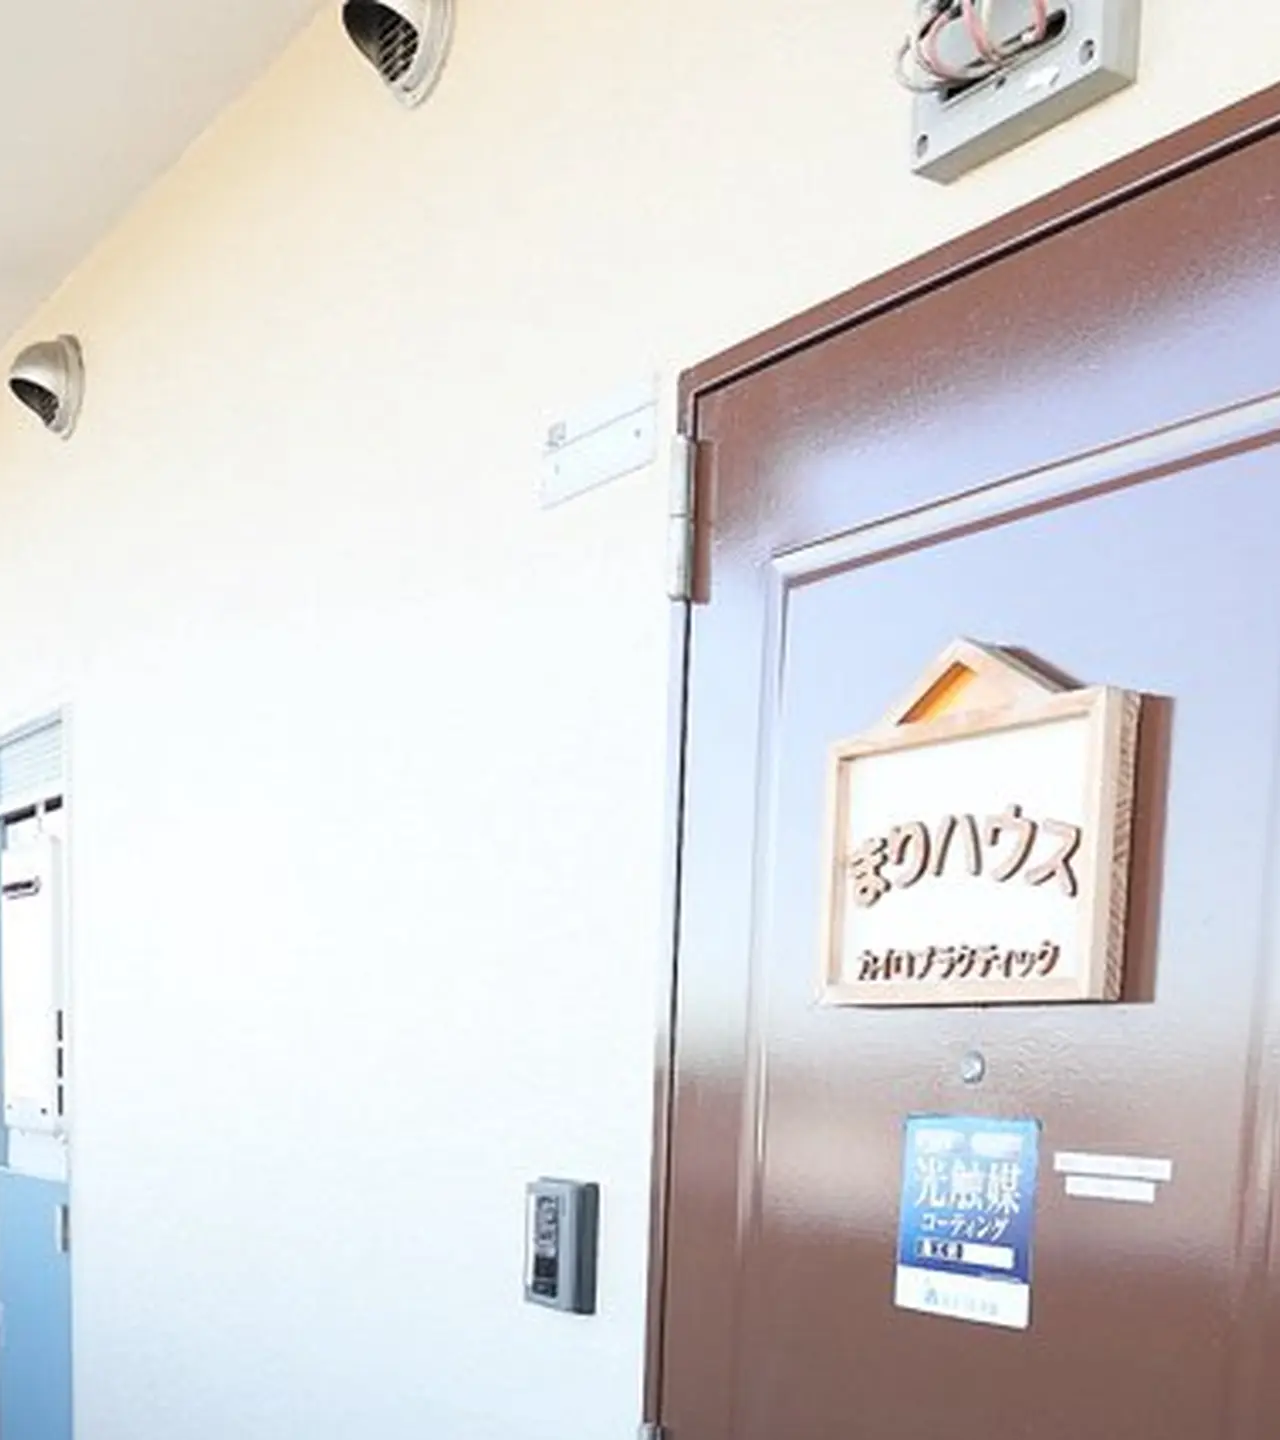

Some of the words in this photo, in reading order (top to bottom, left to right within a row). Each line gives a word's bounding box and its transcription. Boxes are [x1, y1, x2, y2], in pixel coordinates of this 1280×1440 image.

[849, 804, 1083, 908] まりハウス
[920, 1211, 1012, 1241] コーティング
